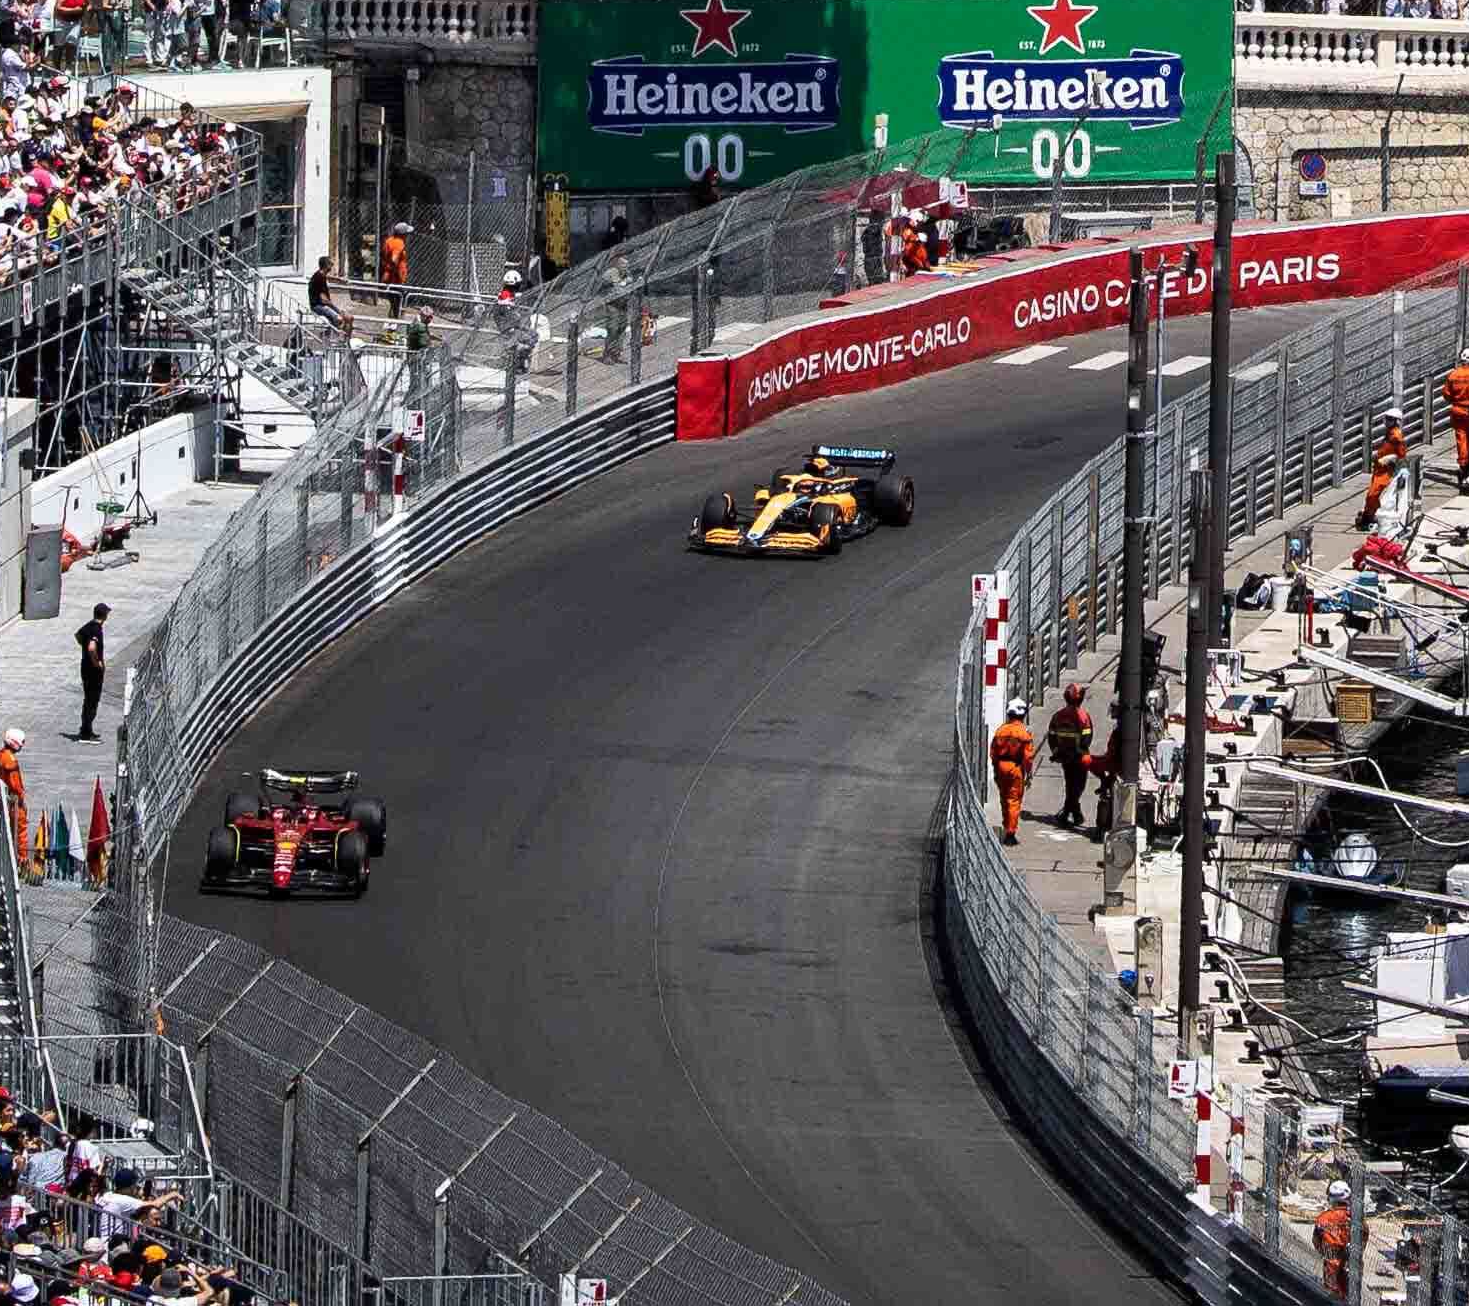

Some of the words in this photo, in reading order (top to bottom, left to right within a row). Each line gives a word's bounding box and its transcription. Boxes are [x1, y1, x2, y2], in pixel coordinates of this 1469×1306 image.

[1018, 40, 1037, 50] EST.
[603, 72, 825, 116] Heineken
[952, 68, 1170, 111] Heineken
[1013, 284, 1101, 329] CASINO
[1239, 252, 1341, 288] PARIS
[746, 361, 795, 407] CASINO
[794, 352, 822, 386] DE
[822, 315, 972, 376] MONTE-CARLO
